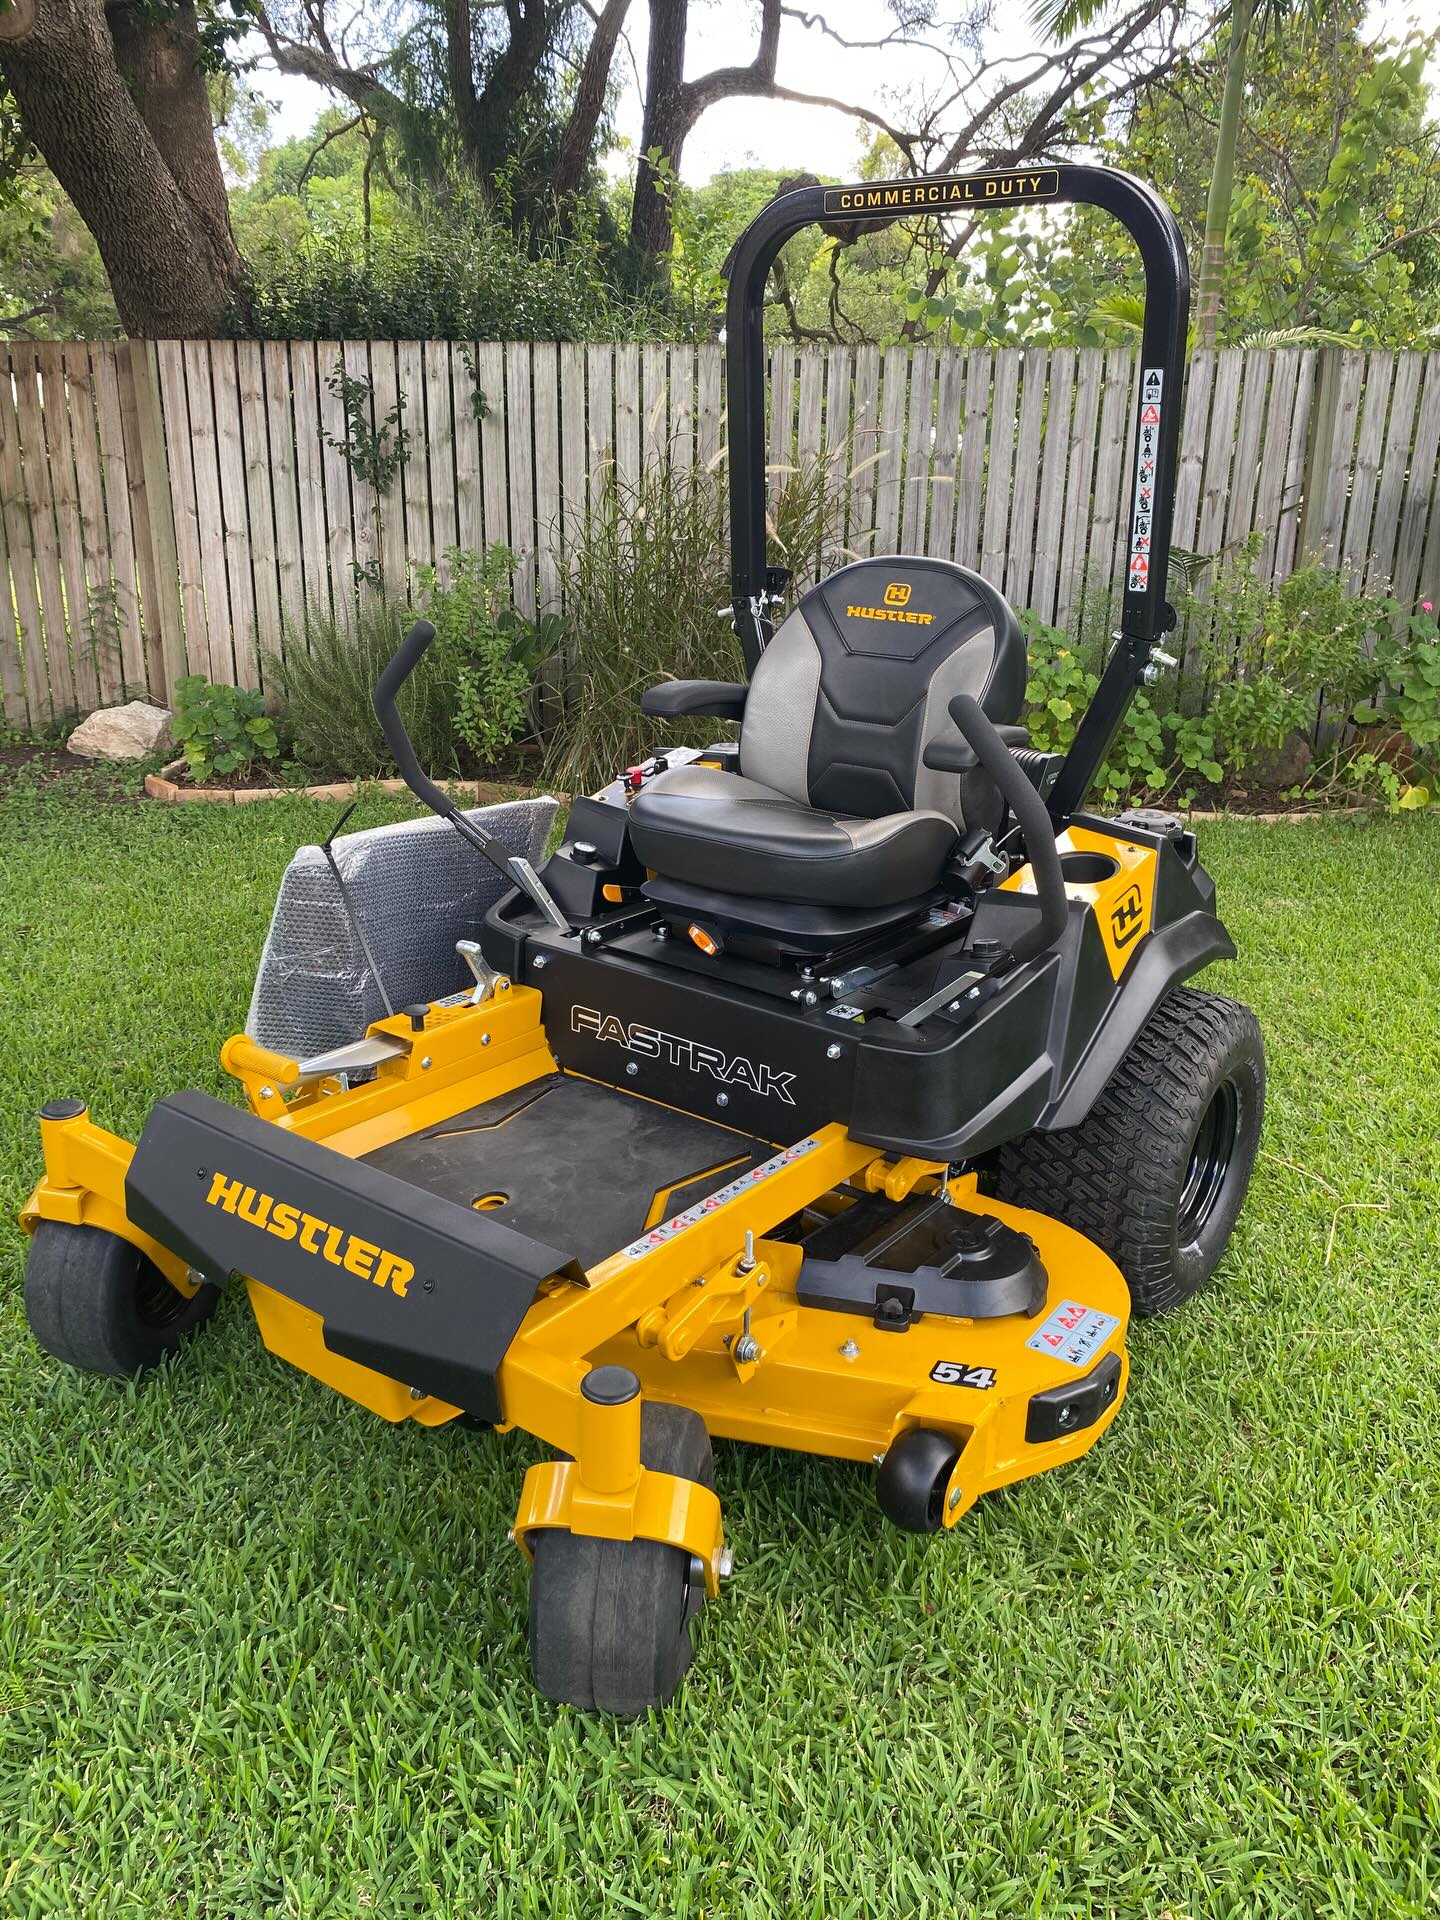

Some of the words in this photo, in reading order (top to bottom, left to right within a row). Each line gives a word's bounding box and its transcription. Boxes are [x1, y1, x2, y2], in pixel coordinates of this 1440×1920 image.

[841, 184, 974, 208] COMMERCIAL
[985, 177, 1041, 197] DUTY
[846, 605, 934, 624] HUSTLER
[571, 1005, 797, 1105] FASTRAK
[206, 1172, 415, 1297] HUSTLER
[932, 1362, 993, 1388] 54
